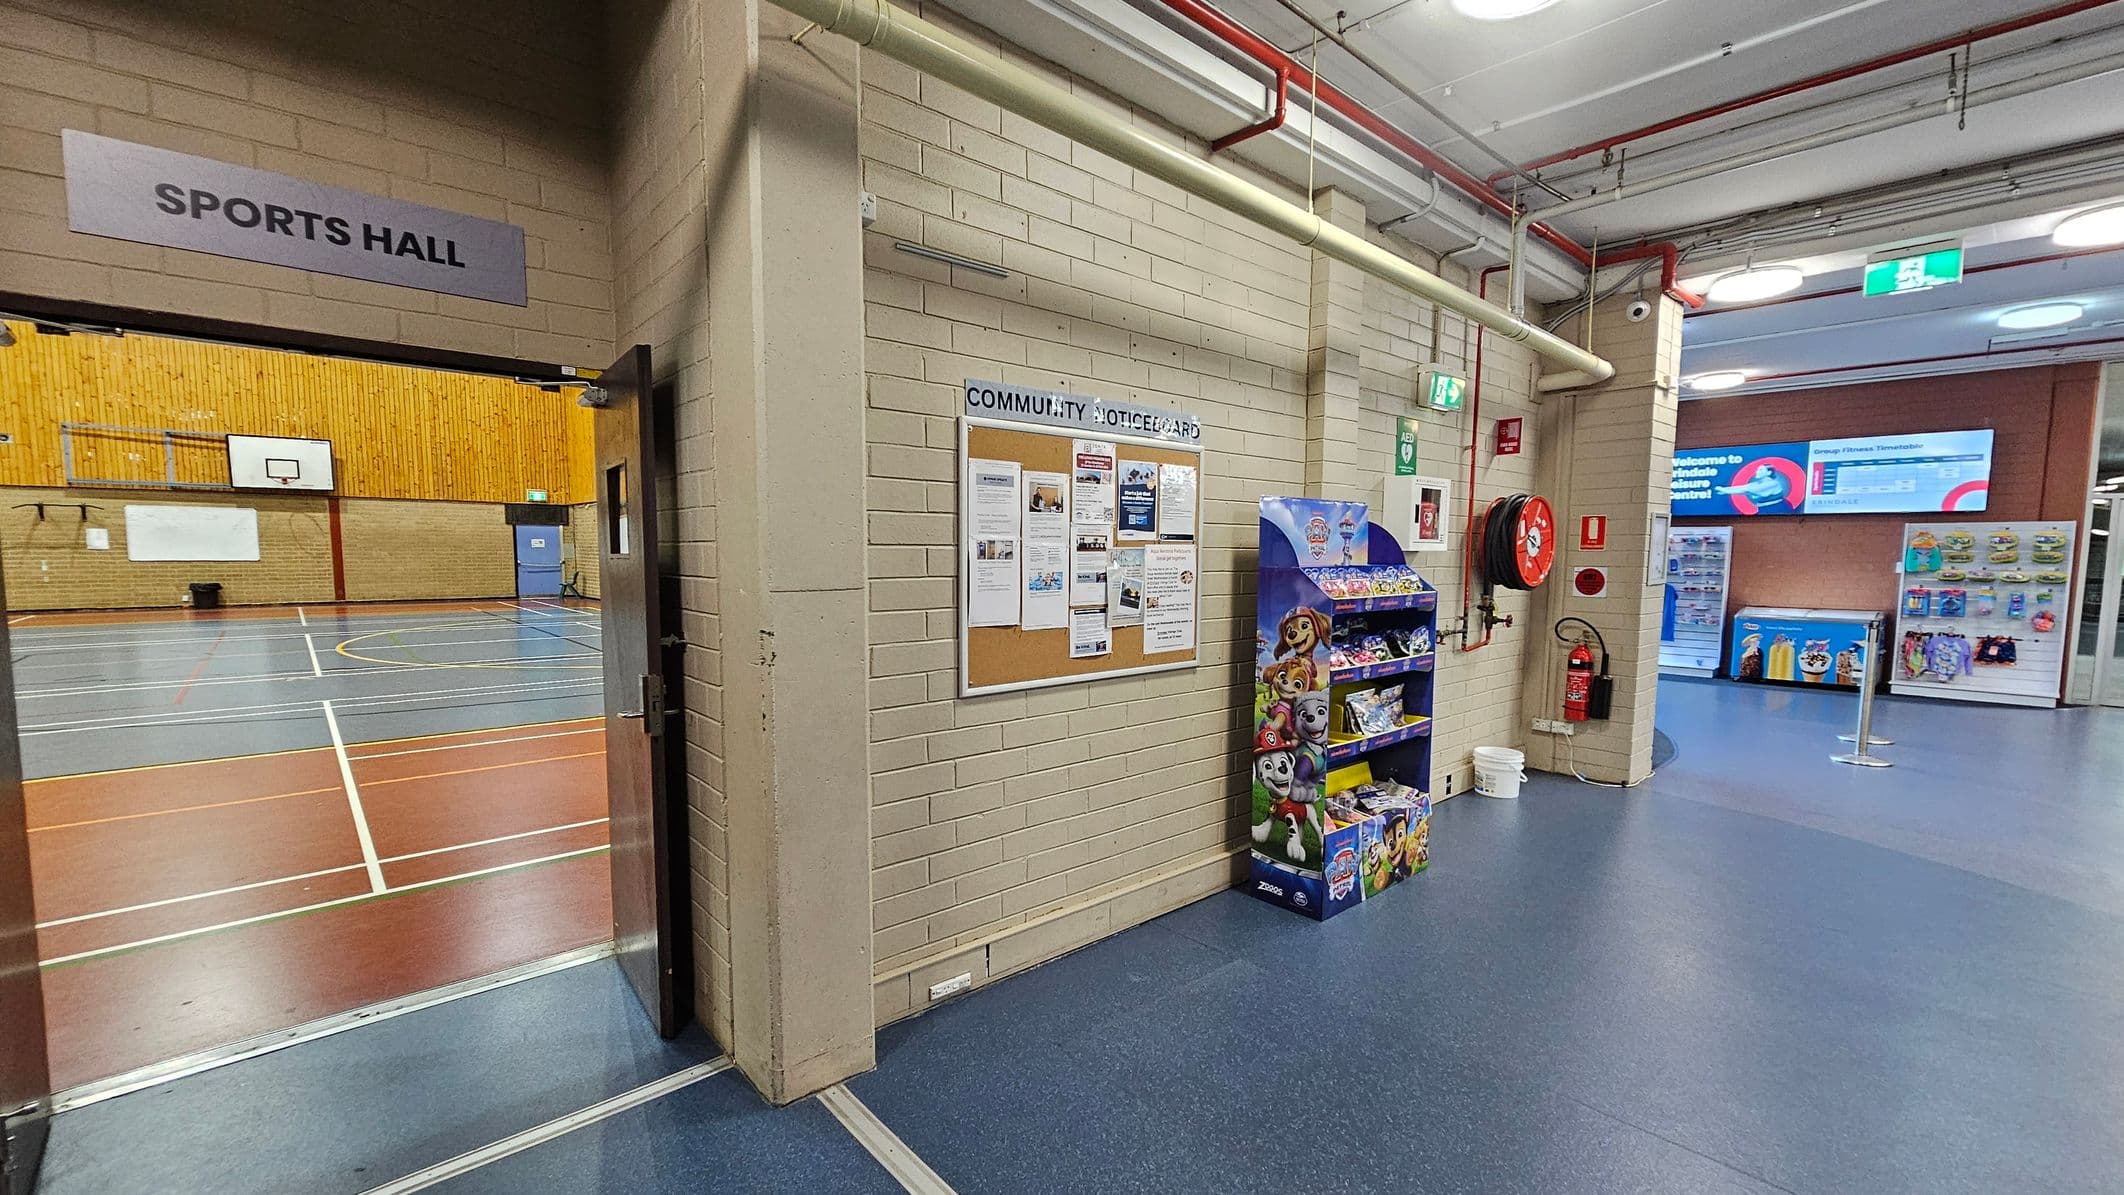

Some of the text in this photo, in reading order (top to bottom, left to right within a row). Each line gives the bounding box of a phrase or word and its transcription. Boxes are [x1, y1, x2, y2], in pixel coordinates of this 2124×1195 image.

[155, 182, 466, 269] SPORTS HALL
[1400, 431, 1415, 444] AED
[1814, 442, 1924, 456] Group Fitness Timetable
[1728, 454, 1743, 464] to
[1672, 467, 1718, 478] rindale
[1670, 478, 1711, 489] eisure
